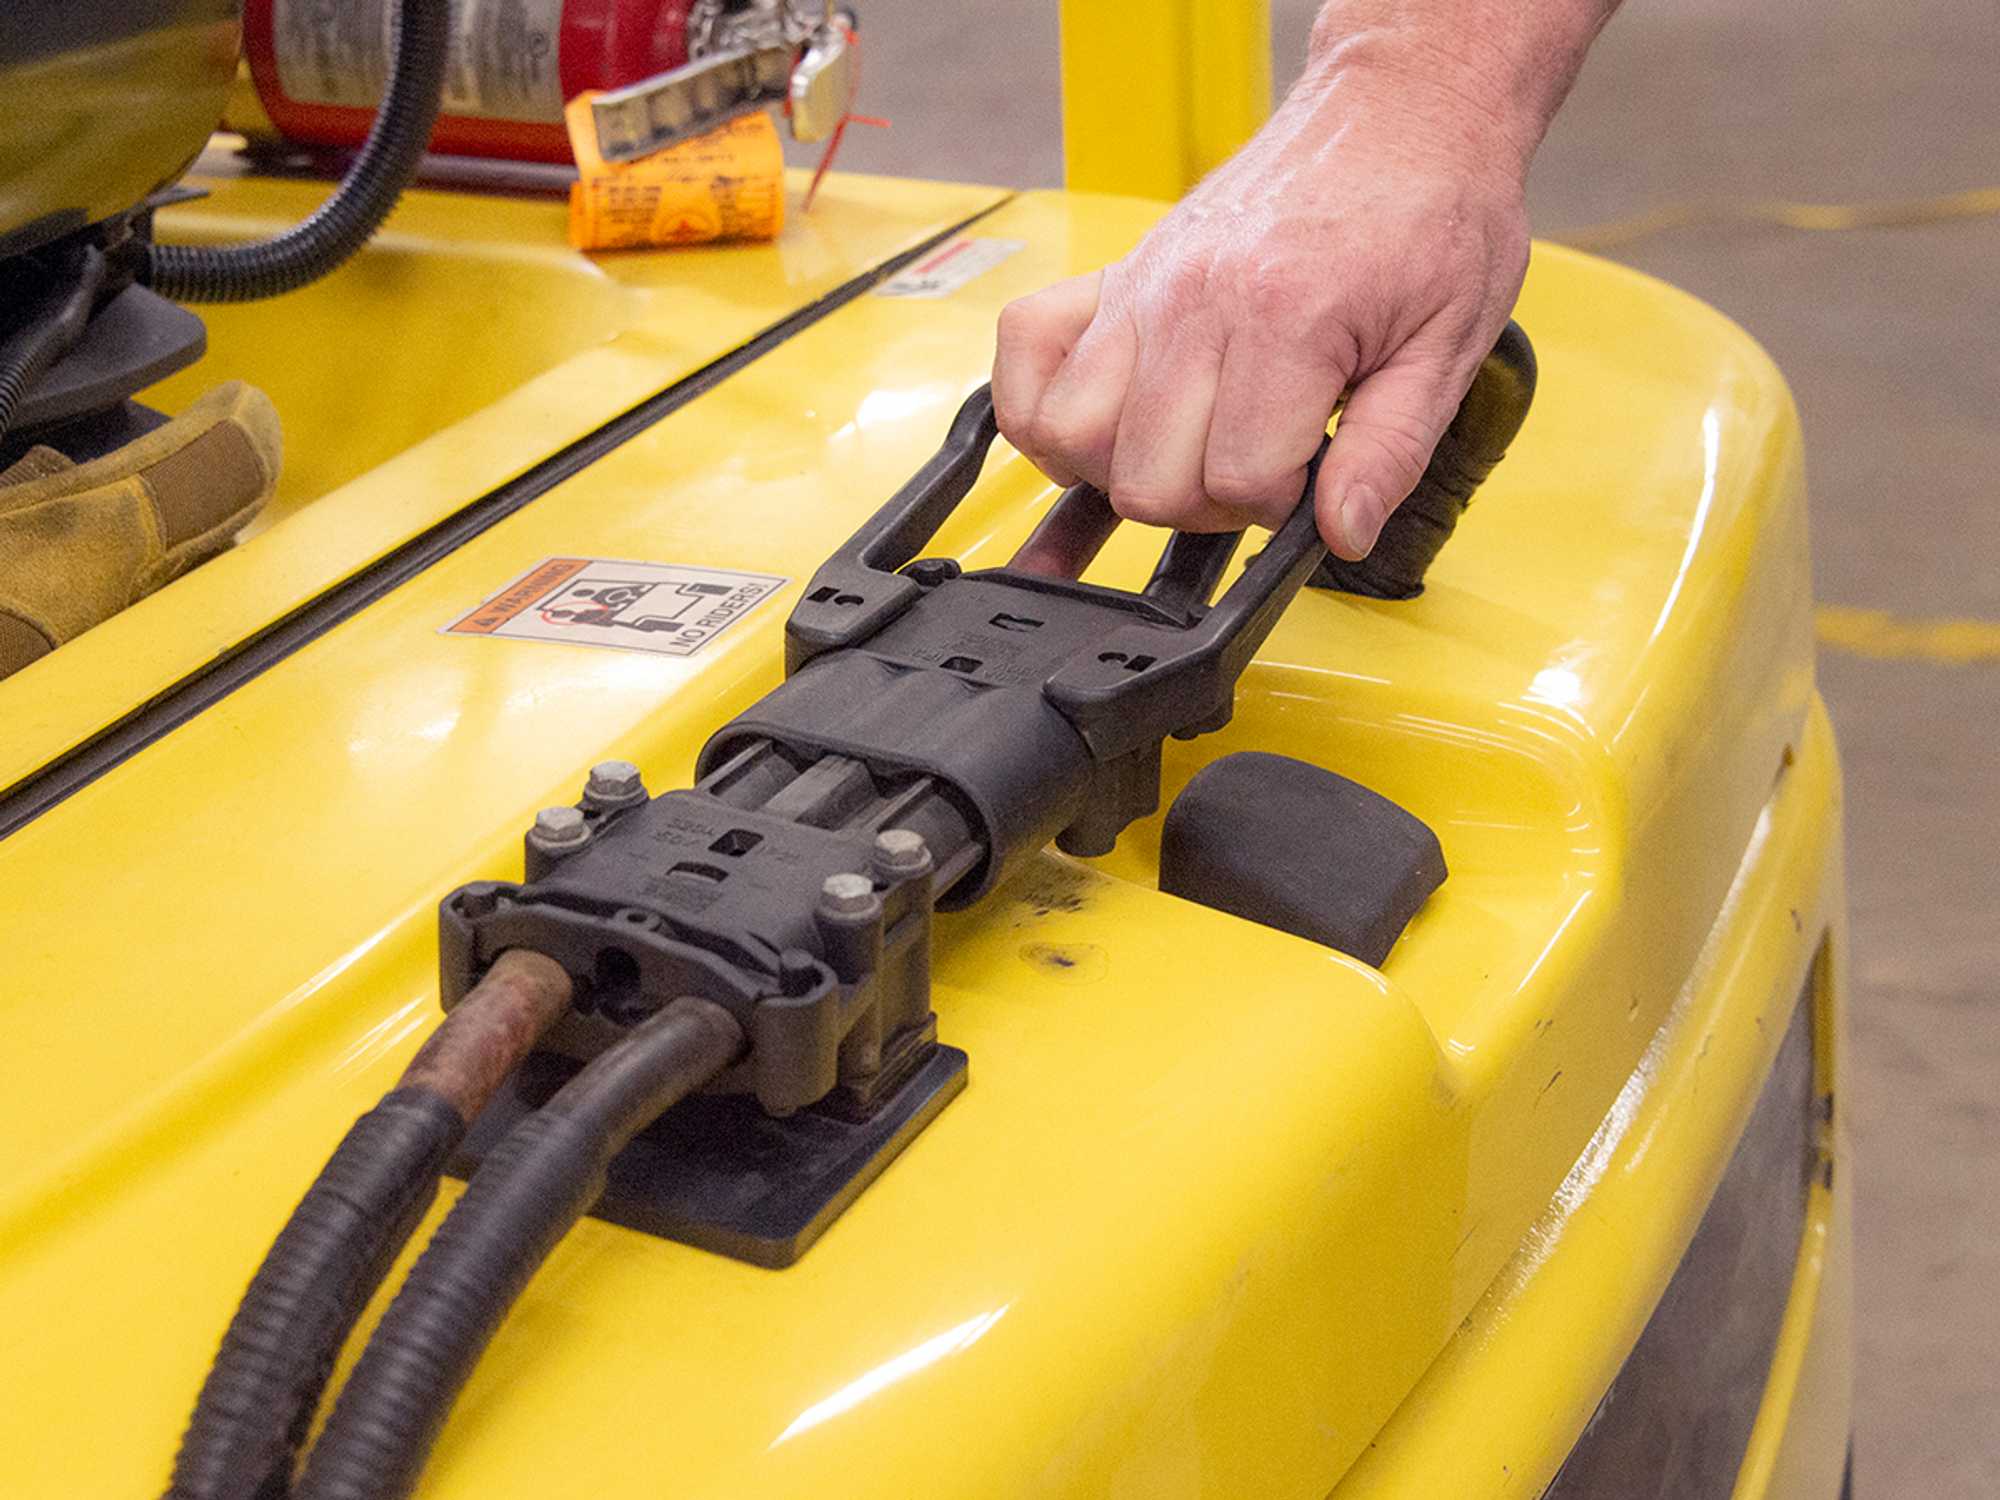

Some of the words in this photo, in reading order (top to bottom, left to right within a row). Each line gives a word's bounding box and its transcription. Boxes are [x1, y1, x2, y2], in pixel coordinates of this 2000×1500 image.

[489, 563, 575, 613] WARNING
[668, 629, 706, 647] NO
[695, 582, 769, 628] RIDERS!
